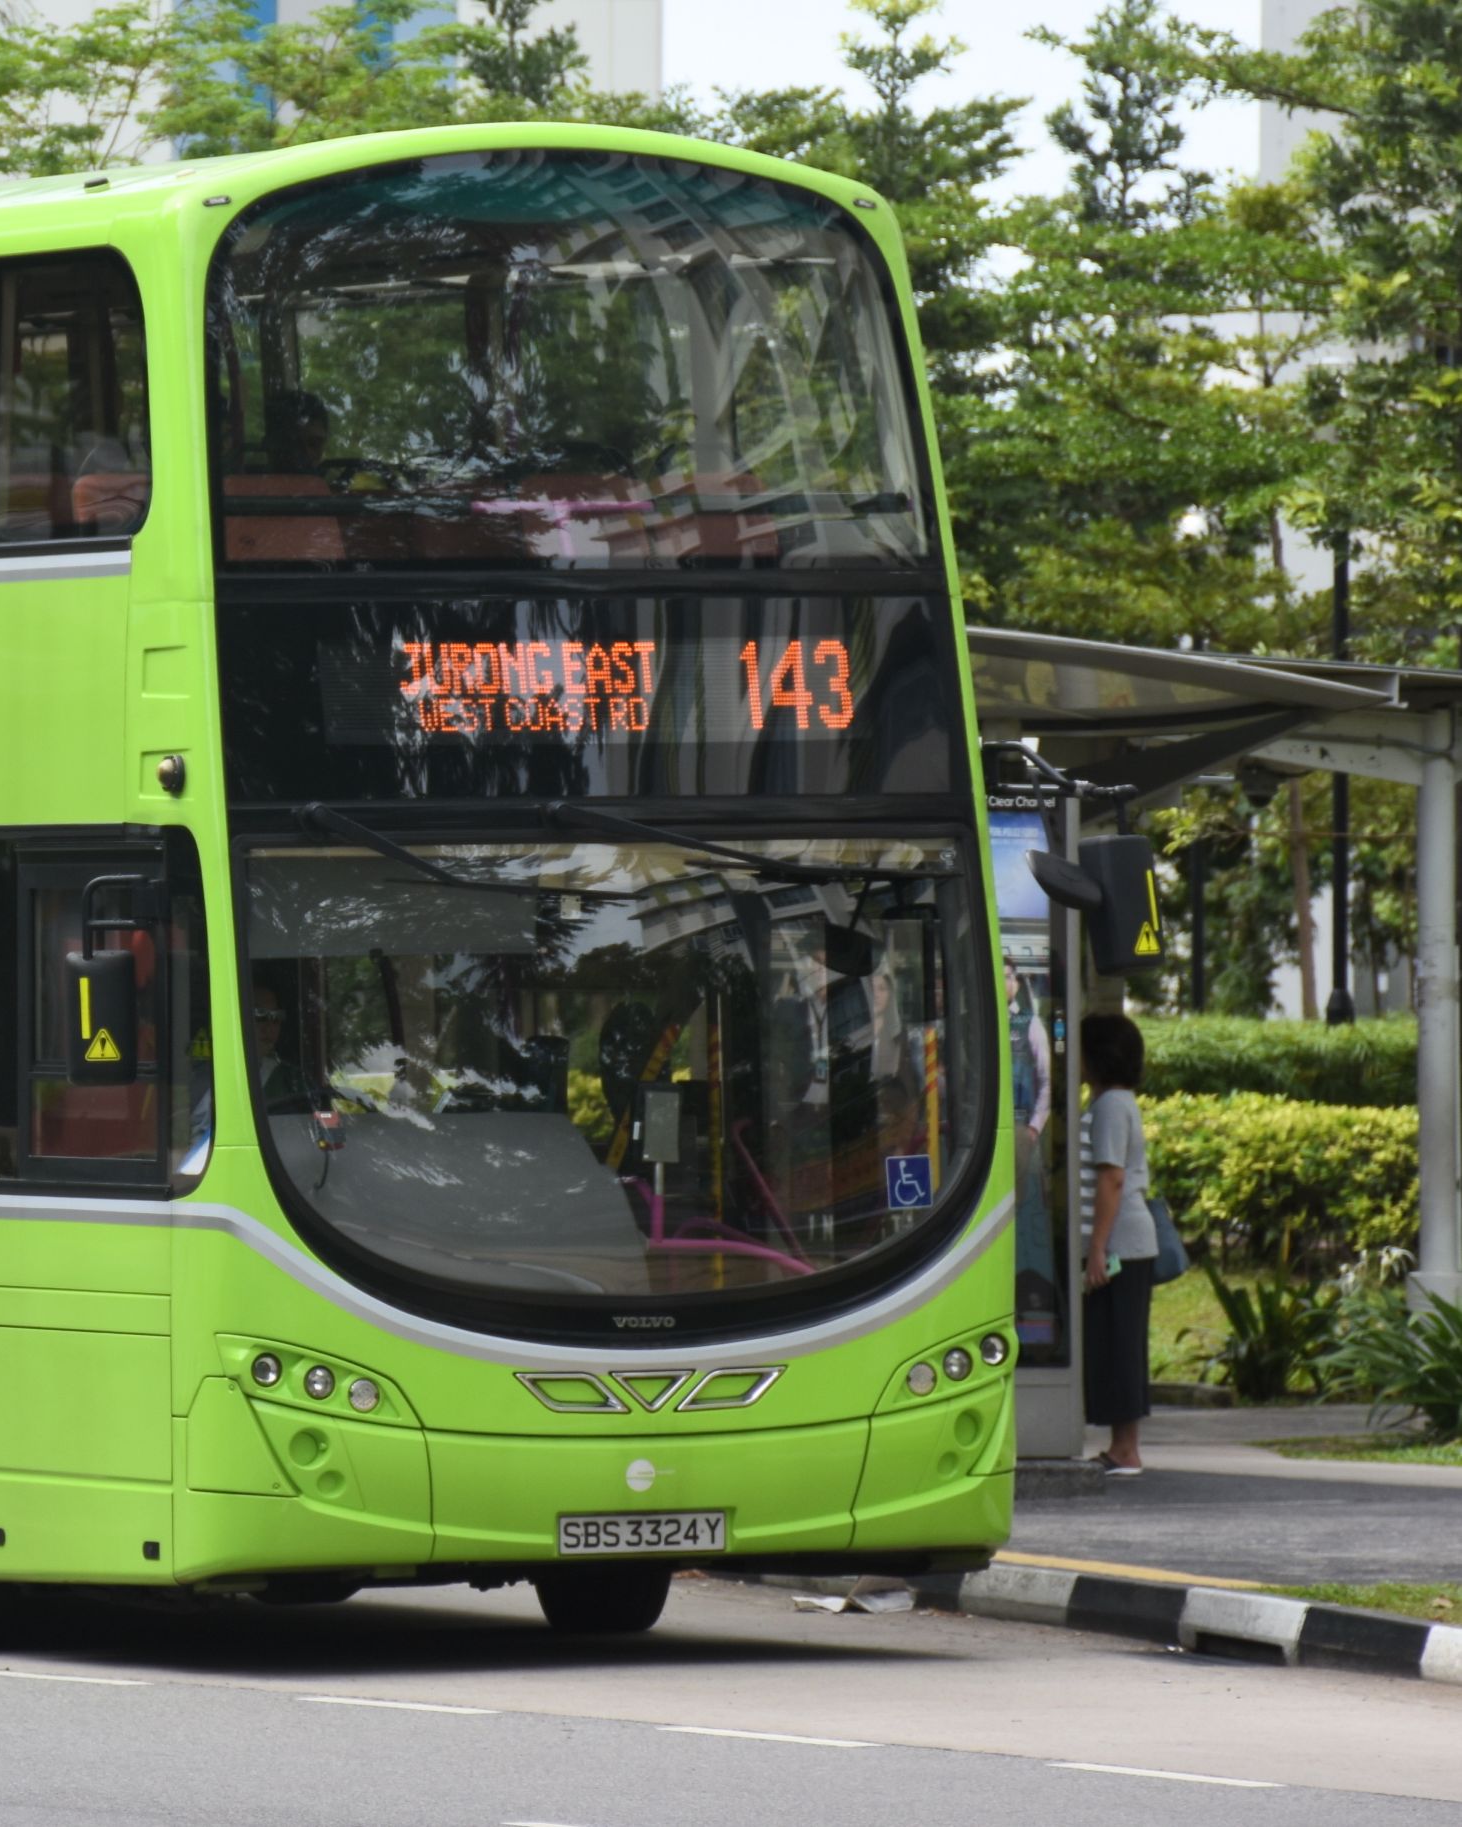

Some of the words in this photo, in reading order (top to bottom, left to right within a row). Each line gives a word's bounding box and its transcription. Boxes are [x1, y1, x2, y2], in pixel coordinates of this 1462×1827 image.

[400, 640, 554, 696] JURONG
[561, 640, 656, 694] EAST
[739, 639, 855, 730] 143
[418, 697, 496, 732] WEST
[504, 697, 601, 732] COAST
[608, 697, 650, 732] RD
[612, 1316, 676, 1328] VOLVO
